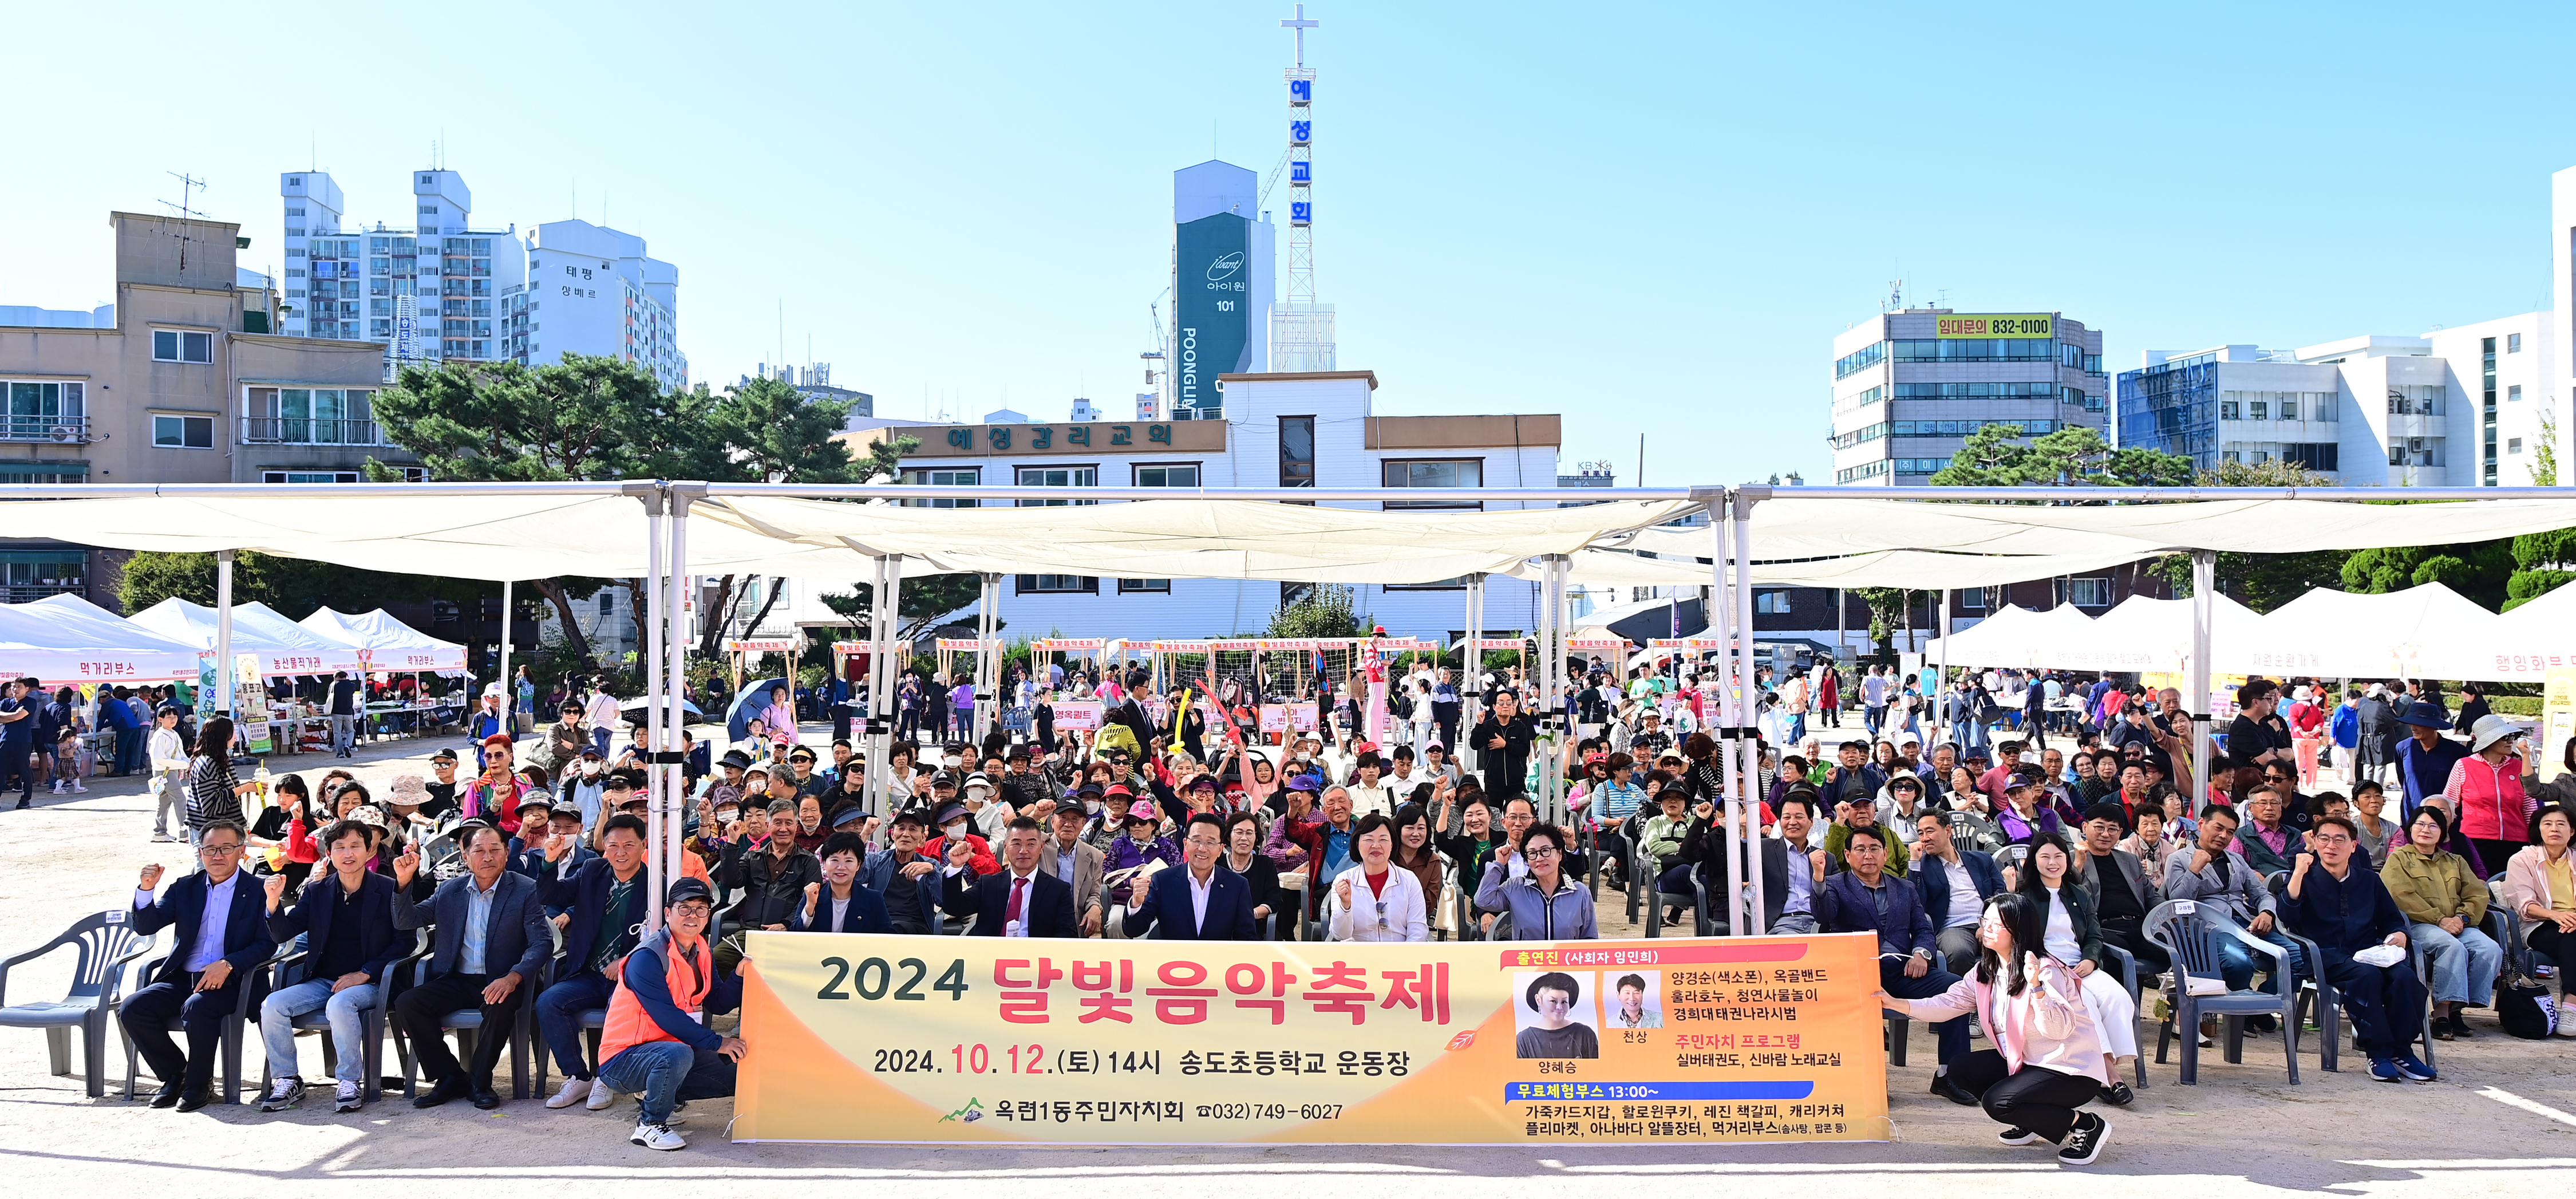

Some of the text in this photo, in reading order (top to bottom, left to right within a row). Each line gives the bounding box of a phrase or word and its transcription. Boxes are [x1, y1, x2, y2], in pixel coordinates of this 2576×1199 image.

[1291, 79, 1311, 223] 예성교회
[567, 265, 593, 281] 태평
[1207, 282, 1245, 291] 아이원
[1216, 300, 1234, 311] 101
[1939, 319, 2048, 334] 임대문의 832-0100
[1049, 638, 1093, 646] 달빛음악축제
[274, 657, 321, 669] 농산물직거래
[408, 654, 434, 666] 먹거리부스
[2253, 653, 2319, 667] 자원순환가게
[80, 662, 135, 676] 먹거리부스
[1055, 710, 1092, 719] 영옥퀼트
[1277, 717, 1302, 725] 빈지
[1516, 950, 1659, 966] 출연진 (사회자 임민희)
[1671, 969, 1828, 985] 양경순(색소폰), 옥골밴드
[817, 956, 1451, 1026] 2024 달빛음악축제
[1671, 988, 1818, 1004] 훌라호누, 청연사물놀이
[1674, 1007, 1796, 1021] 경희대태권나라시범
[1623, 1031, 1647, 1044] 천상
[1675, 1034, 1800, 1050] 주민자치 프로그램
[874, 1049, 942, 1074] 2024.
[953, 1043, 997, 1074] 10.
[1109, 1050, 1160, 1075] 14시
[1179, 1050, 1327, 1076] 송도초등학교
[1336, 1050, 1410, 1076] 운동장
[1676, 1052, 1841, 1068] 실버태권도, 신바람 노래교실
[1539, 1061, 1577, 1074] 양혜승
[1517, 1083, 1659, 1099] 무료체험부스 13:00~
[995, 1100, 1183, 1123] 옥련1동주민자치회
[1525, 1103, 1844, 1121] 가죽카드지갑, 할로윈쿠키, 레진 책갈피, 캐리커쳐
[1525, 1121, 1847, 1138] 플리마켓, 아나바다 알뜰장터, 먹거리부스(솜사탕, 팝콘 등)
